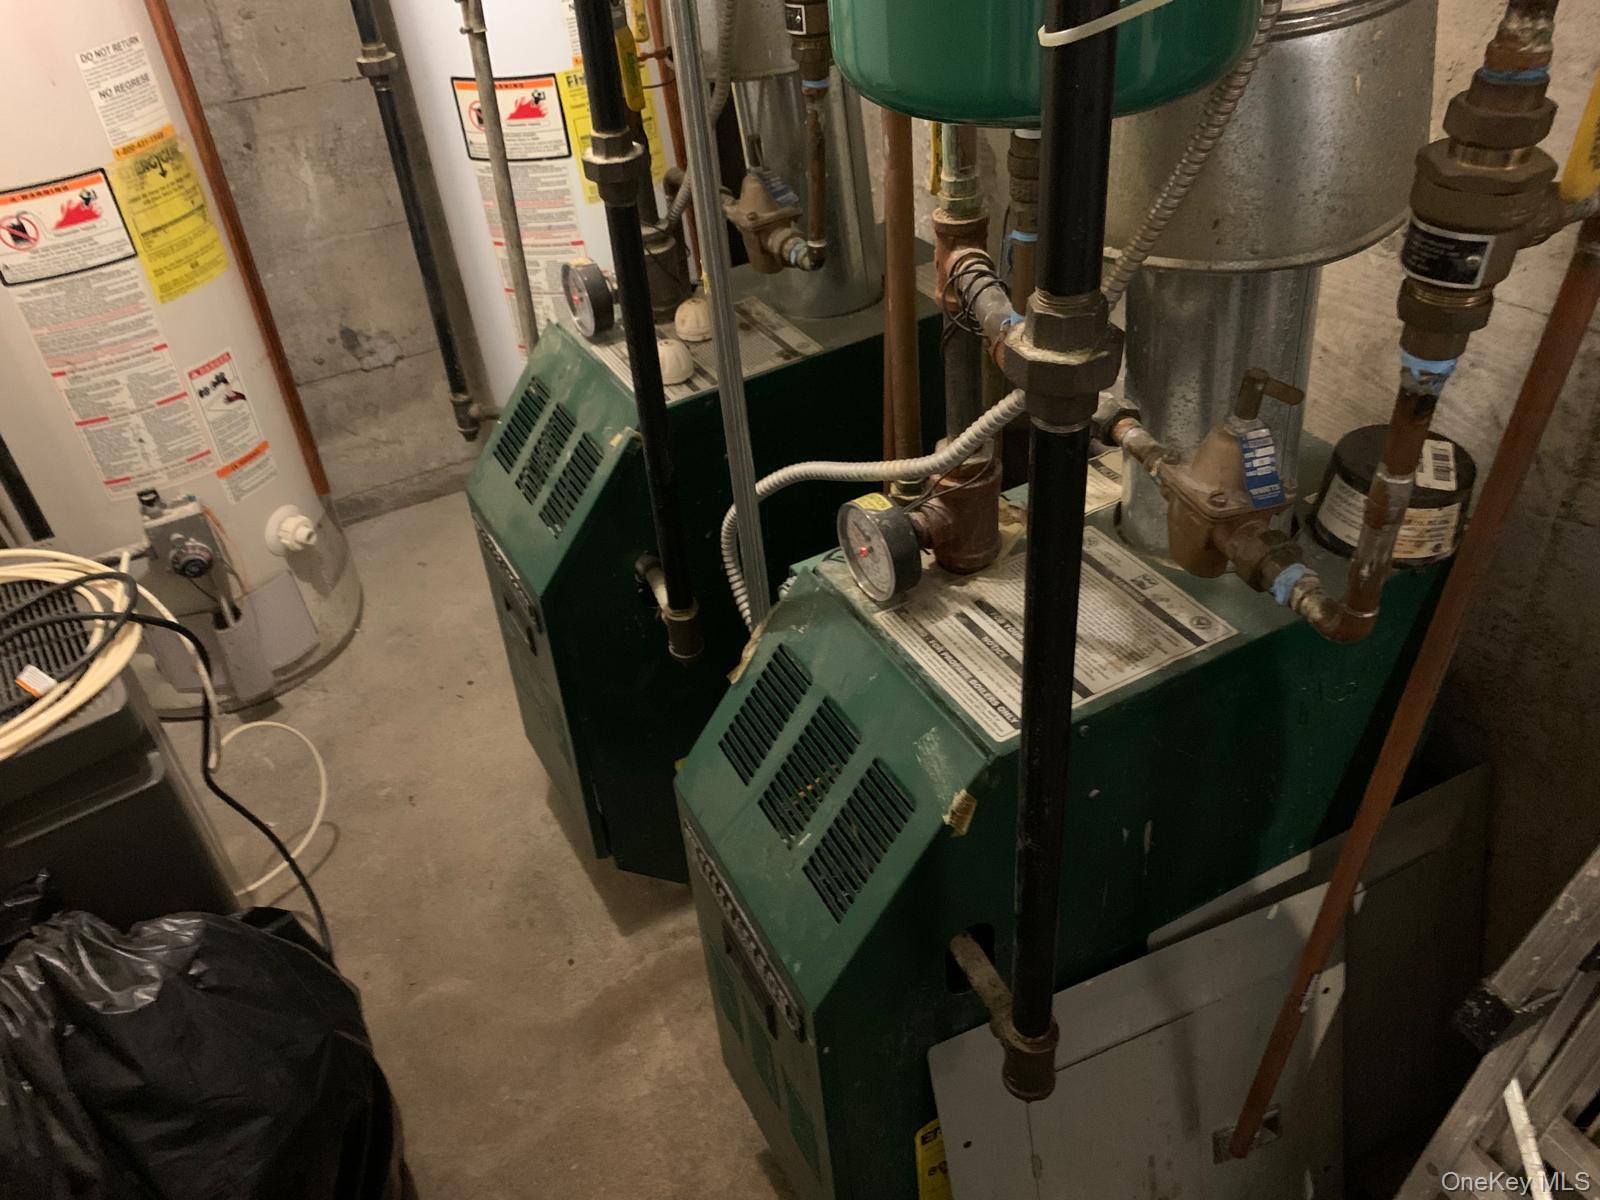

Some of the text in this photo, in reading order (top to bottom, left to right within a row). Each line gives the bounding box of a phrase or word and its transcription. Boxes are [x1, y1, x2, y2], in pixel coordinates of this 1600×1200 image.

[79, 35, 140, 64] DO NOT RETURN
[97, 88, 113, 99] NO
[20, 184, 70, 201] WARNING
[981, 634, 1009, 658] NOTICE
[929, 639, 946, 654] FOR
[940, 650, 972, 680] PROPANE
[968, 679, 1000, 707] BOILERS
[997, 705, 1019, 724] ONLY
